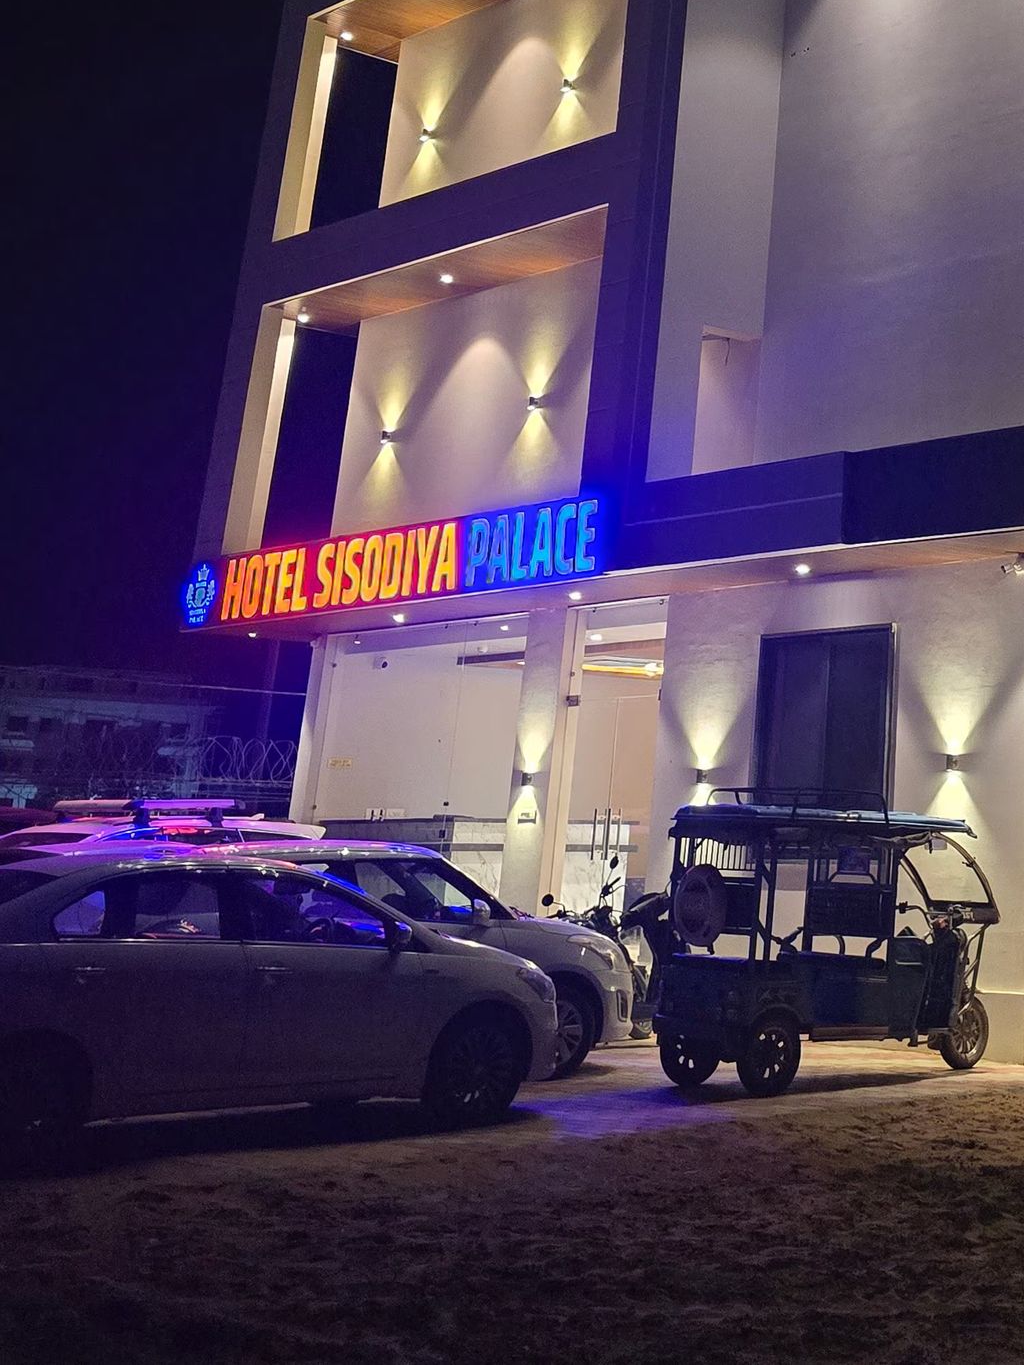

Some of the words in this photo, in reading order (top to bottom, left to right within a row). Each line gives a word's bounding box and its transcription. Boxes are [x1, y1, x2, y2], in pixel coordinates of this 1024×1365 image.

[220, 547, 308, 621] HOTEL
[312, 521, 460, 608] SISODIYA
[464, 499, 599, 587] PALACE
